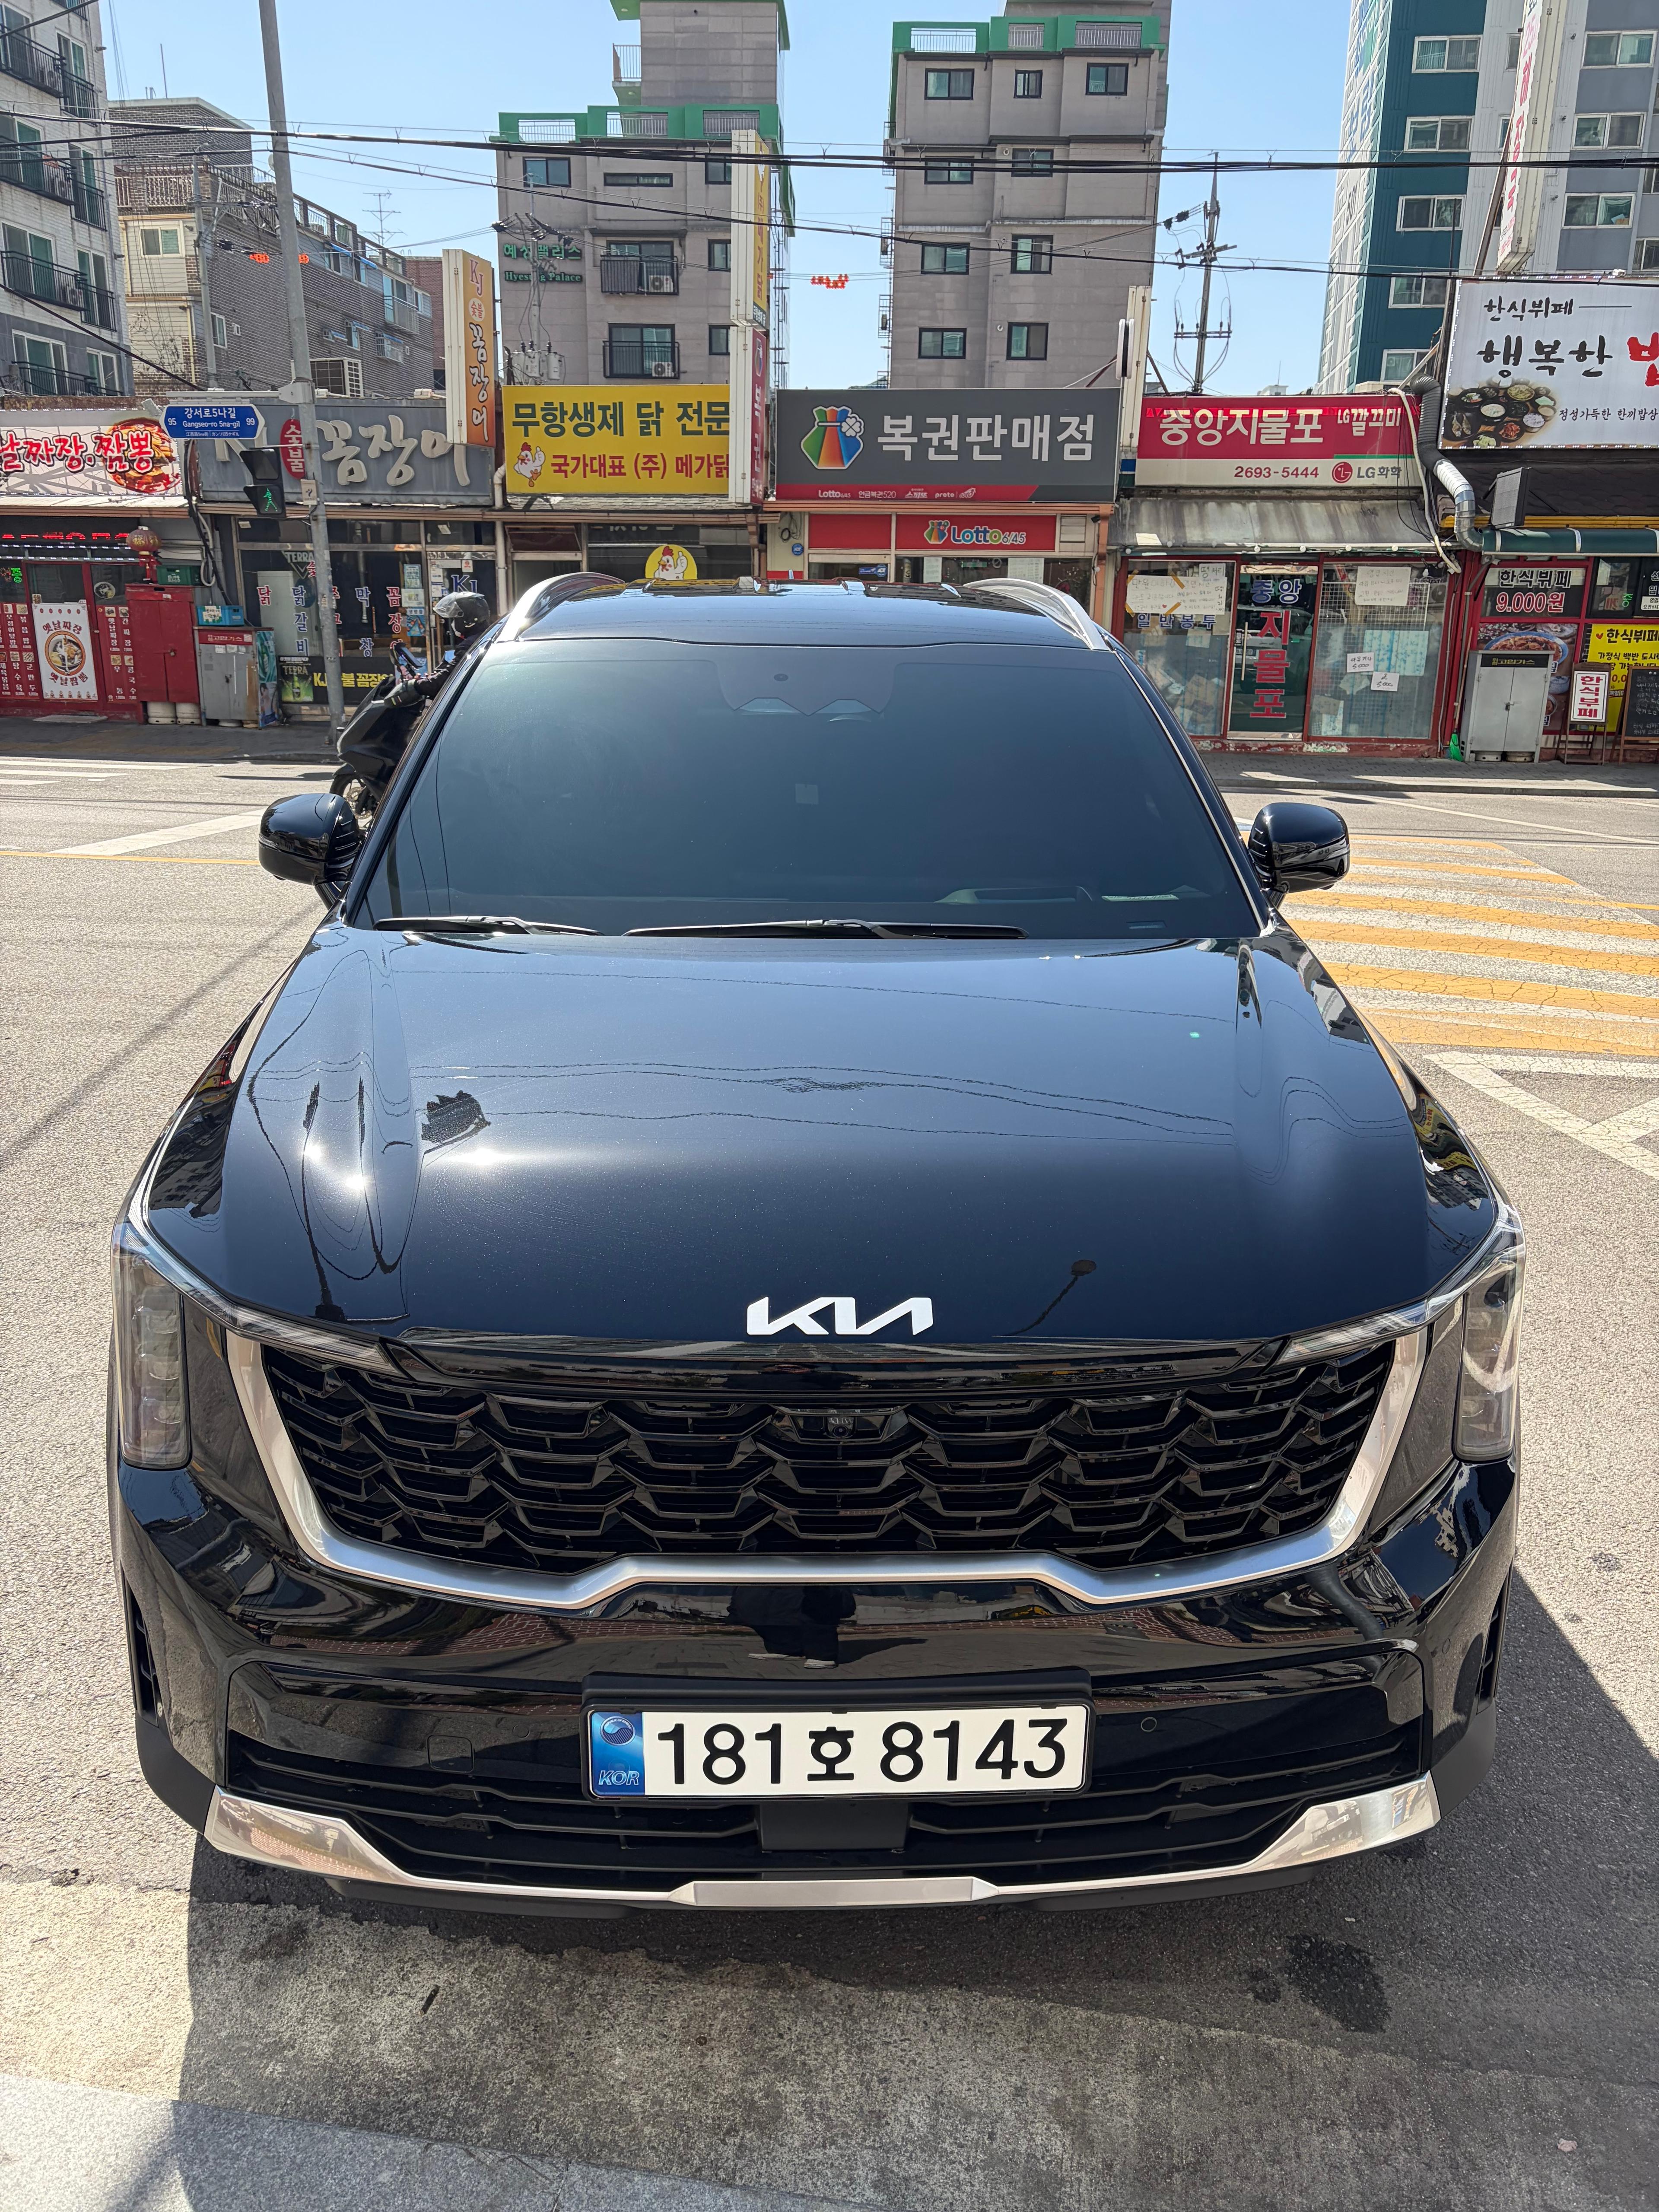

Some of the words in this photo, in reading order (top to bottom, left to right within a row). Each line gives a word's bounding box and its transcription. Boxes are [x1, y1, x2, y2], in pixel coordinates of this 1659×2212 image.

[549, 271, 581, 281] Palace
[1484, 296, 1574, 321] 한식뷔페
[1477, 334, 1613, 378] 행복한
[184, 407, 236, 419] 강서로5나길
[512, 401, 624, 438] 무항생제
[636, 401, 664, 437] 닭
[676, 400, 730, 436] 전문
[1558, 408, 1611, 421] 정성가득한
[182, 420, 217, 429] Gangseo-ro
[219, 420, 240, 429] 5na-gil
[1160, 409, 1323, 446] 중앙지물포
[877, 414, 1094, 462] 복권판매점
[551, 454, 627, 479] 국가대표
[675, 454, 729, 479] 메가닭
[1234, 466, 1319, 478] 2693-5444
[286, 552, 314, 563] TERRA
[1499, 569, 1572, 589] 한식뷔페
[257, 585, 271, 606] 닭
[1253, 579, 1301, 604] 중앙
[42, 620, 83, 635] 옛날짜장
[292, 585, 309, 657] 닭갈비
[354, 586, 374, 657] 막창
[1137, 613, 1217, 629] 일반봉투
[1606, 628, 1659, 644] 한식뷔페
[1249, 610, 1292, 719] 지물포
[1598, 652, 1621, 661] 가정식
[1623, 652, 1639, 661] 백반
[879, 1718, 1069, 1785] 8143
[598, 1770, 640, 1786] KOR
